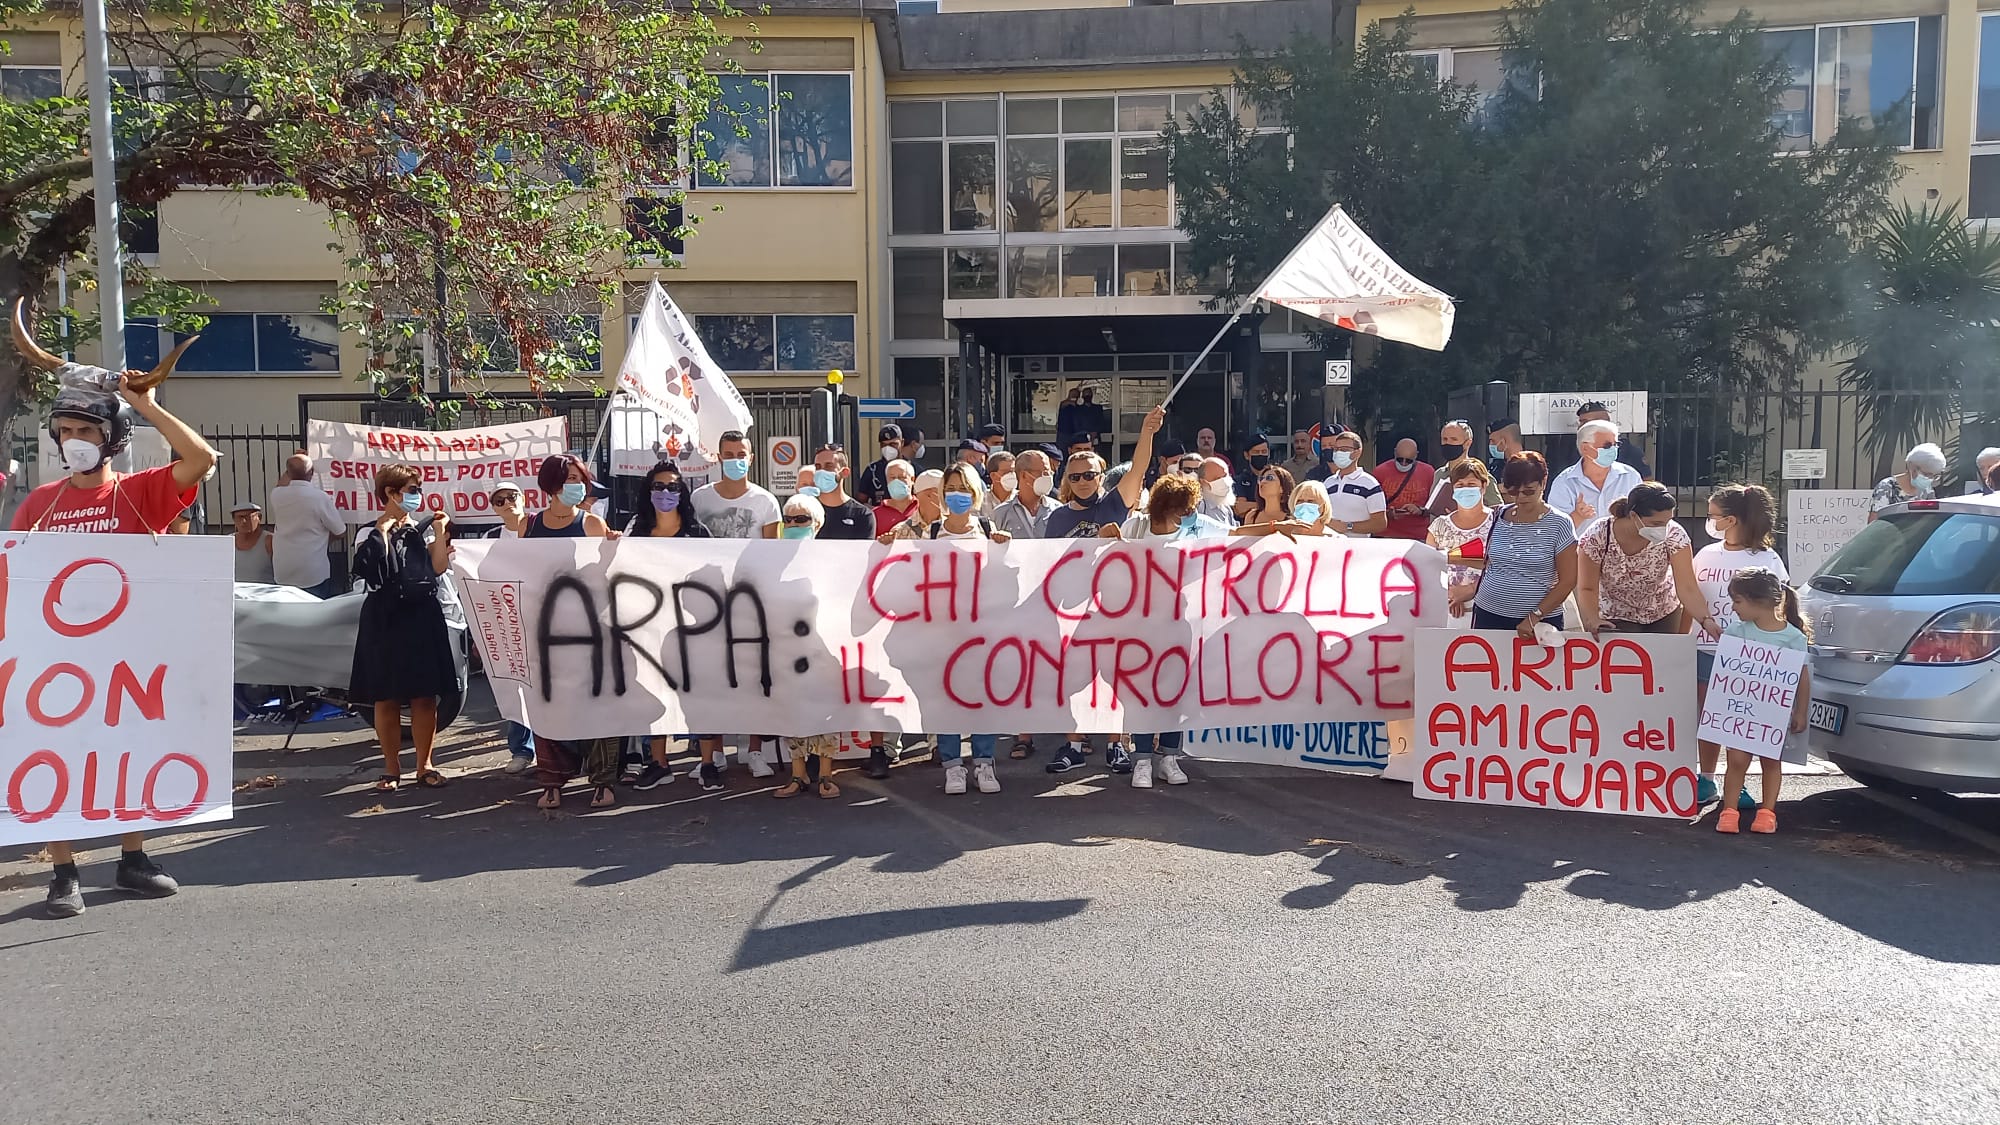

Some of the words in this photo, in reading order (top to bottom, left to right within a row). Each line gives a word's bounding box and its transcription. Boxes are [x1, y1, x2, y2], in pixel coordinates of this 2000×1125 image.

[1329, 365, 1348, 380] 52
[1551, 398, 1580, 408] ARPA
[1588, 398, 1616, 408] Lzio
[367, 431, 426, 451] ARPA
[435, 433, 500, 452] Lazio
[457, 458, 542, 481] POTERE
[52, 505, 107, 522] VILLAGGIO
[325, 490, 357, 511] AI
[1799, 497, 1813, 510] LE
[1797, 514, 1848, 525] ERCANO
[1795, 542, 1814, 553] NO
[1823, 542, 1842, 553] DIS
[867, 551, 982, 623] CHI
[1043, 545, 1420, 621] CONTROLLA
[475, 602, 487, 613] DI
[482, 621, 500, 662] ALBANO
[538, 570, 810, 703] ARPA:
[1445, 635, 1664, 695] A.R.P.A.
[1740, 644, 1782, 666] NON
[841, 642, 905, 705] IL
[943, 631, 1411, 712] CONTROLLORE
[1720, 655, 1799, 686] VOGLIAMO
[1712, 673, 1795, 708] MORIRE
[1727, 698, 1755, 717] PER
[1304, 721, 1388, 759] DOVERE
[1428, 702, 1600, 757] AMICA
[1623, 716, 1675, 752] del
[1701, 710, 1784, 746] DECRETO
[1423, 751, 1697, 818] GIAGUARO
